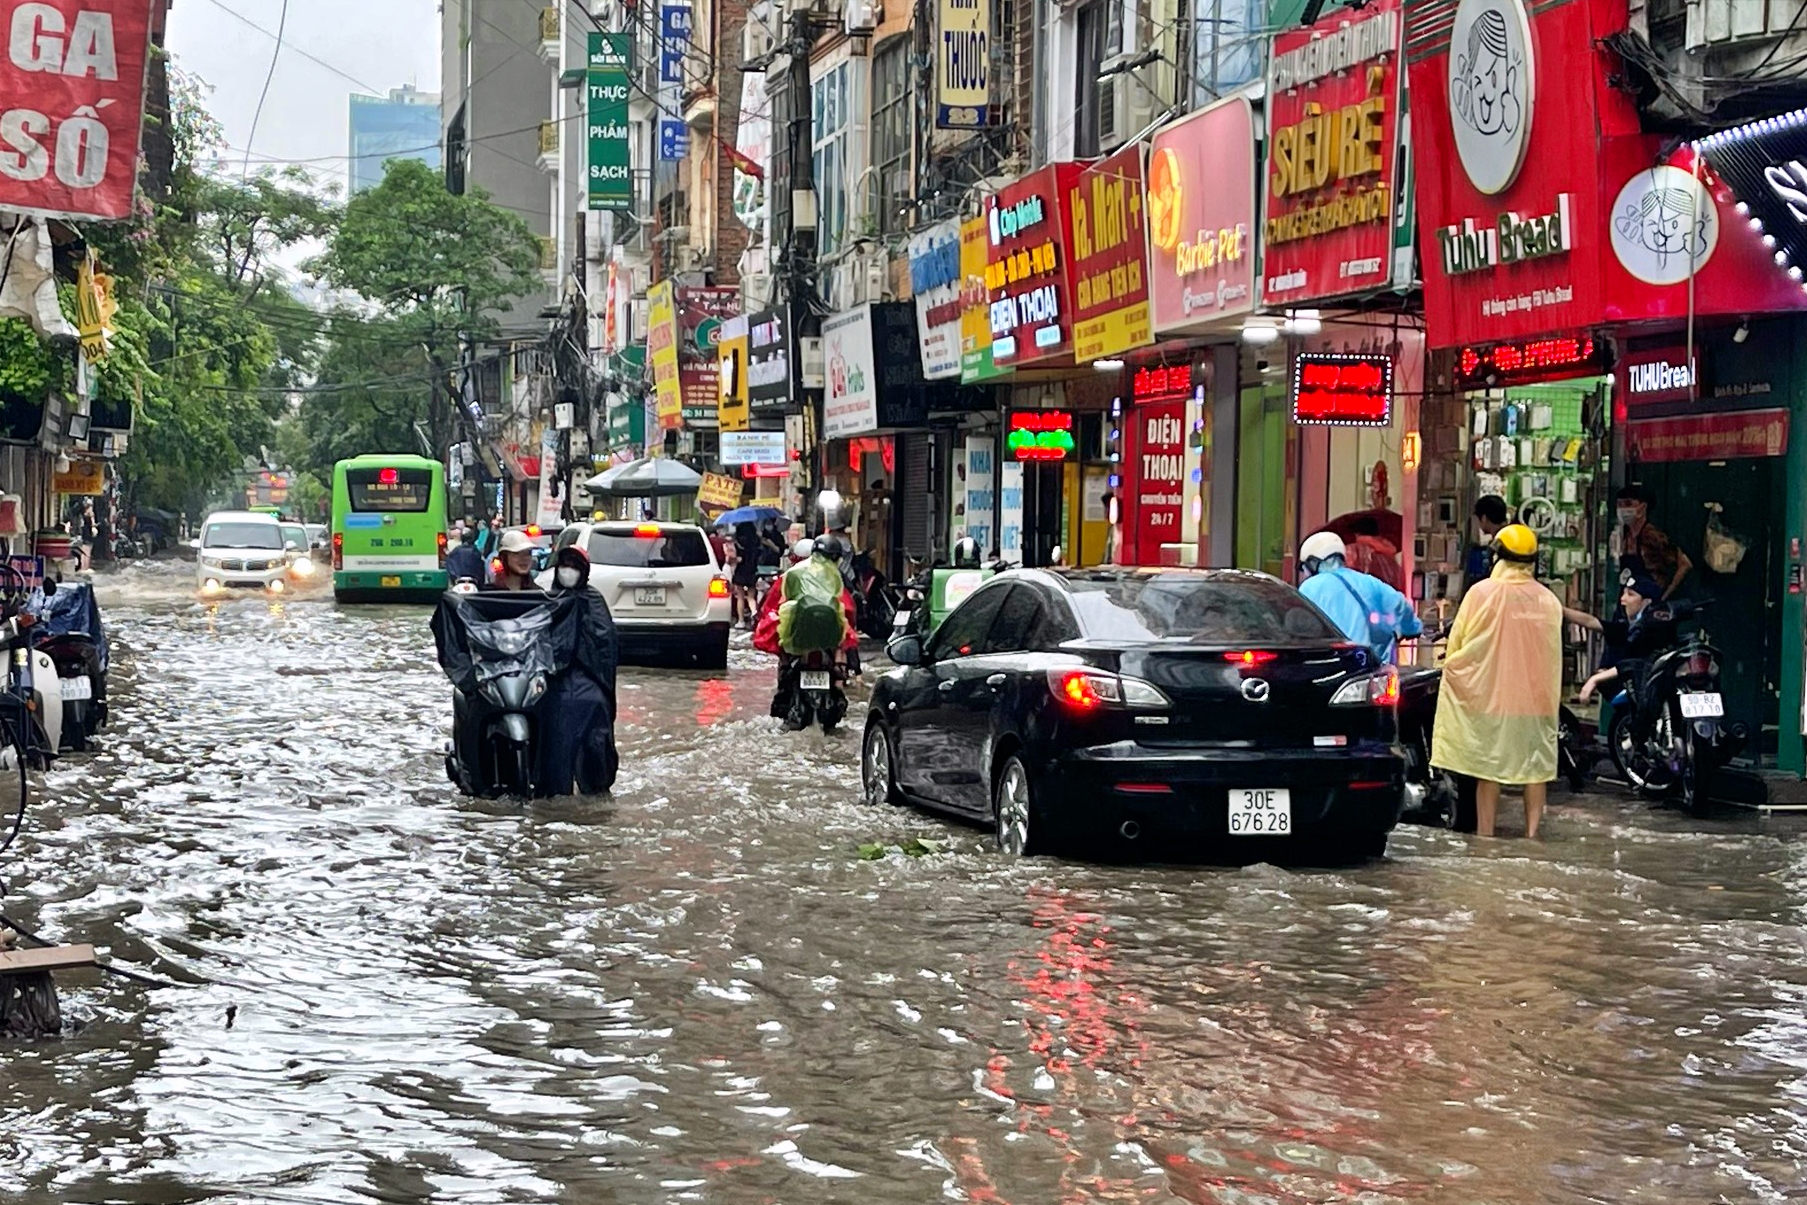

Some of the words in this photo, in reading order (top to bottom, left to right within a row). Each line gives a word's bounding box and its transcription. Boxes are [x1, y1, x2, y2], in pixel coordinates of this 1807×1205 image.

[9, 2, 118, 81] GA
[944, 11, 986, 90] THUỐC
[590, 84, 627, 102] THỰC
[0, 98, 117, 188] SỐ
[590, 119, 628, 139] PHẨM
[1272, 102, 1338, 198] SIÊU
[1338, 66, 1386, 179] RẺ
[590, 165, 628, 181] SẠCH
[1092, 166, 1128, 253] Mart
[1436, 217, 1497, 275] Tuhu
[1497, 193, 1571, 263] Bread
[1176, 229, 1217, 277] Barbie
[1218, 223, 1247, 263] Pet
[991, 290, 1018, 336] ĐIỆN
[1019, 284, 1058, 324] THOẠI
[1147, 413, 1181, 450] ĐIỆN
[970, 446, 991, 474] NHÀ
[1143, 454, 1183, 486] THOẠI
[1244, 791, 1276, 810] 30E
